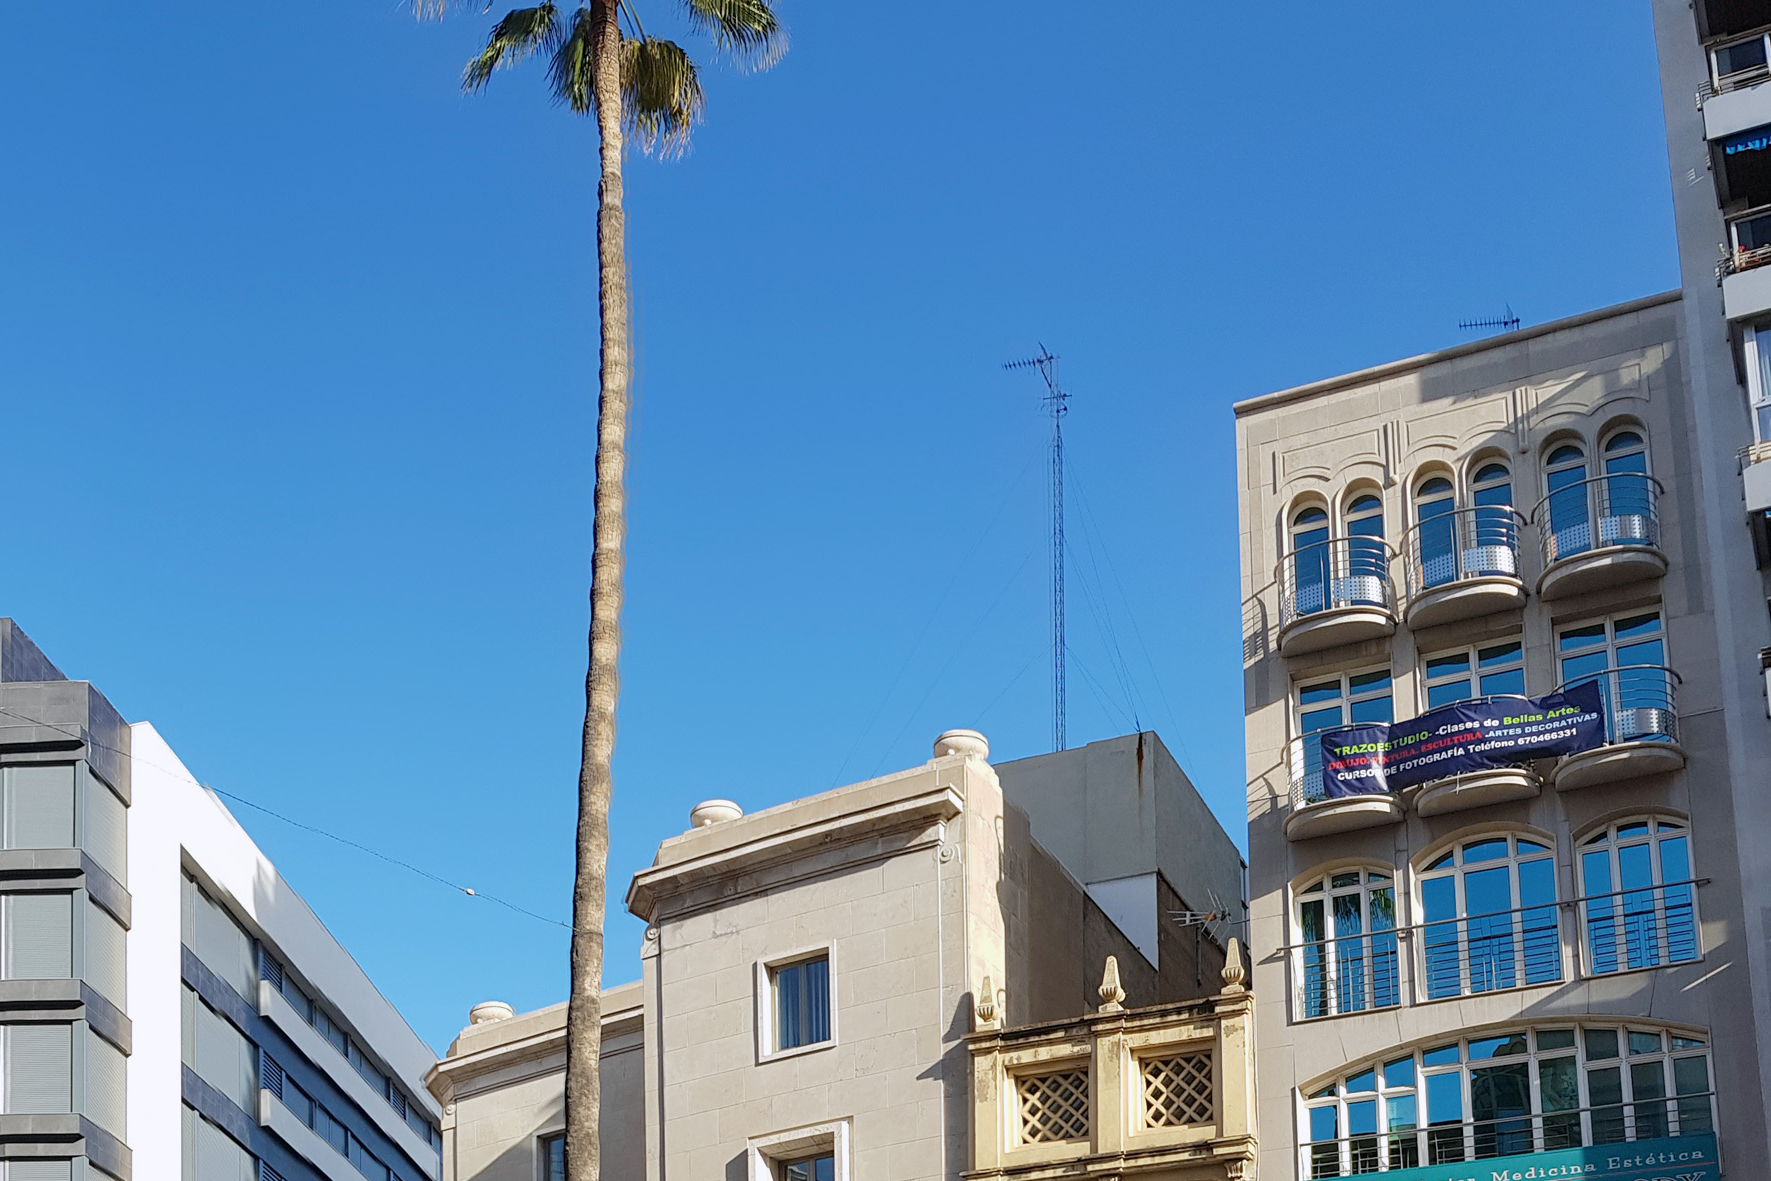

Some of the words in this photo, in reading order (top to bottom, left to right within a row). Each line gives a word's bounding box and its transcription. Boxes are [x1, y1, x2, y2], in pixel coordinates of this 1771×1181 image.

[1484, 718, 1499, 727] de
[1503, 713, 1543, 725] Bellas
[1547, 705, 1581, 719] Artes
[1421, 731, 1482, 752] ESCULTURA
[1524, 712, 1598, 733] DECORATIVAS
[1384, 766, 1397, 776] DE
[1399, 744, 1465, 771] FOTOGRAFÍA
[1468, 738, 1515, 753] Teléfono
[1518, 728, 1577, 745] 670466331
[1607, 1149, 1704, 1169] Estética
